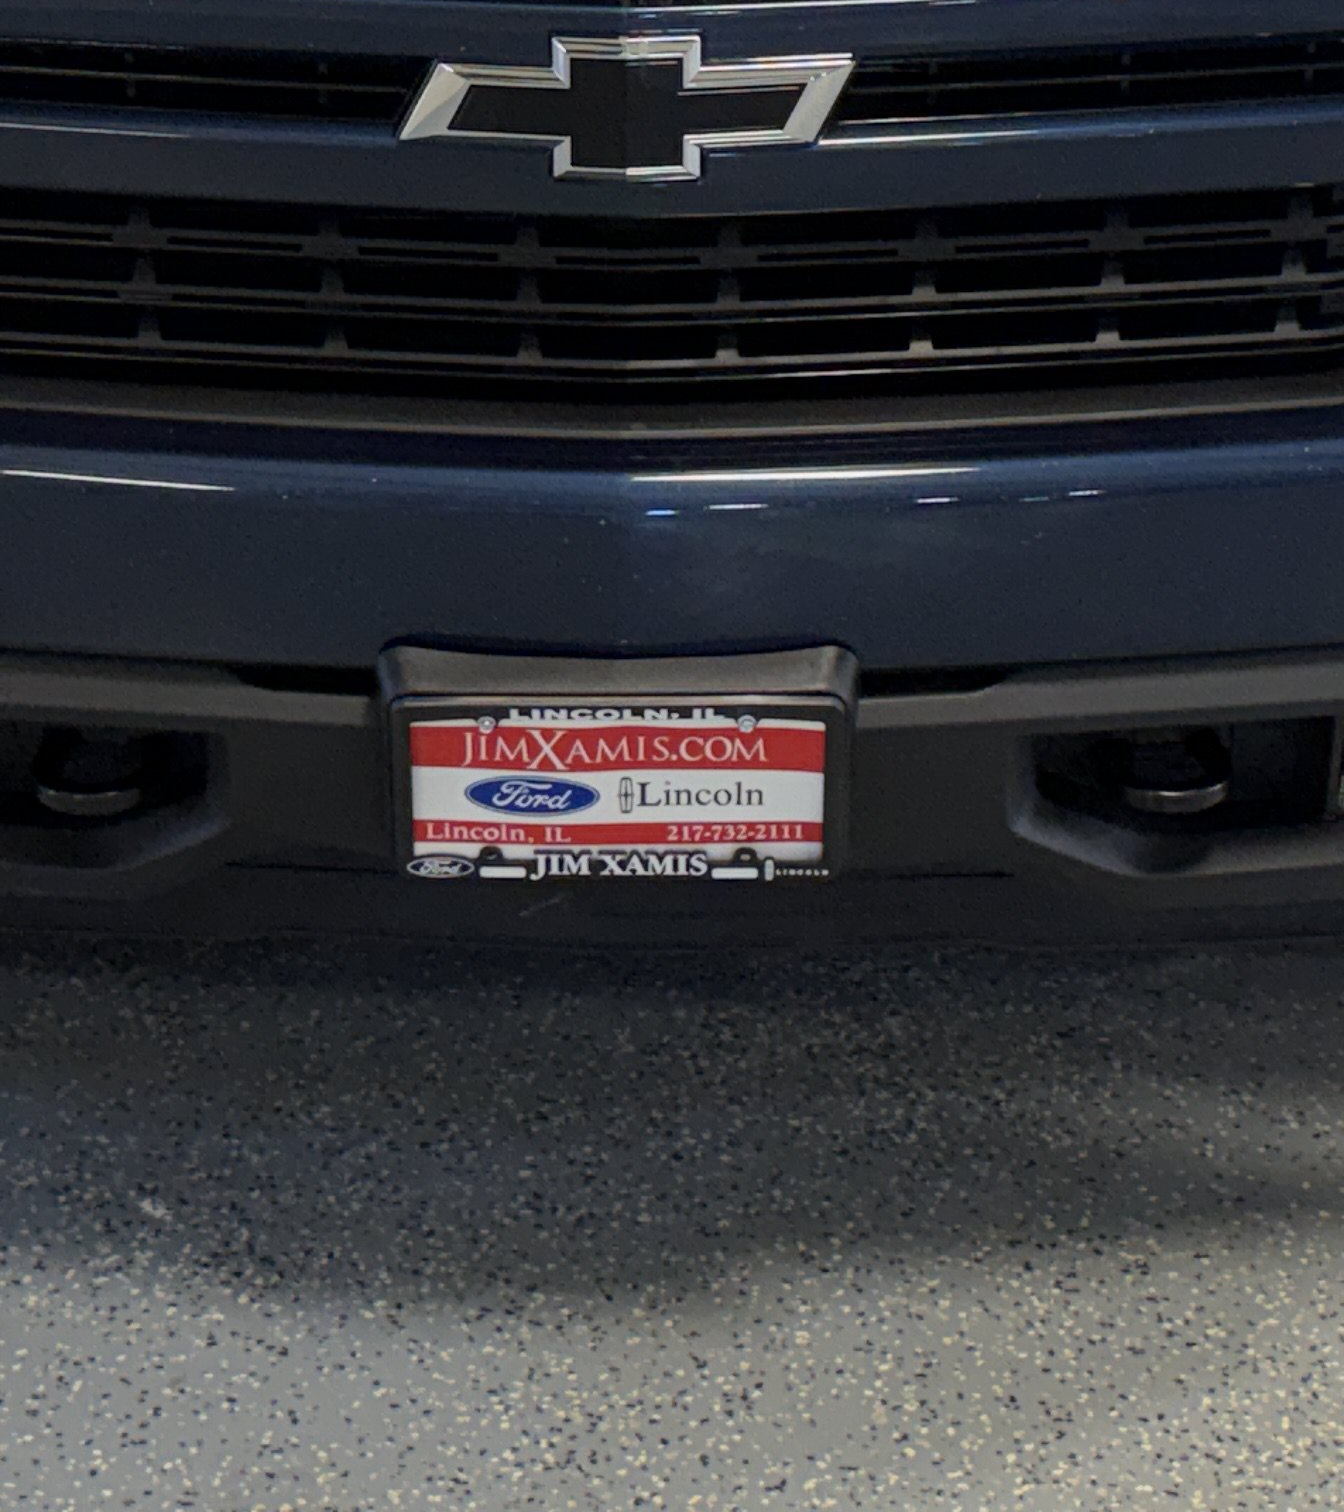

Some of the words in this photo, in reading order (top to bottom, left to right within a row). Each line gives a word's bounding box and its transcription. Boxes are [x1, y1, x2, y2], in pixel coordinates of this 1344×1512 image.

[491, 780, 572, 812] Ford
[636, 781, 764, 808] Lincoln
[544, 825, 571, 843] IL
[666, 825, 804, 842] 217-732-2111
[529, 851, 592, 881] JIM
[598, 851, 708, 877] XAMIS
